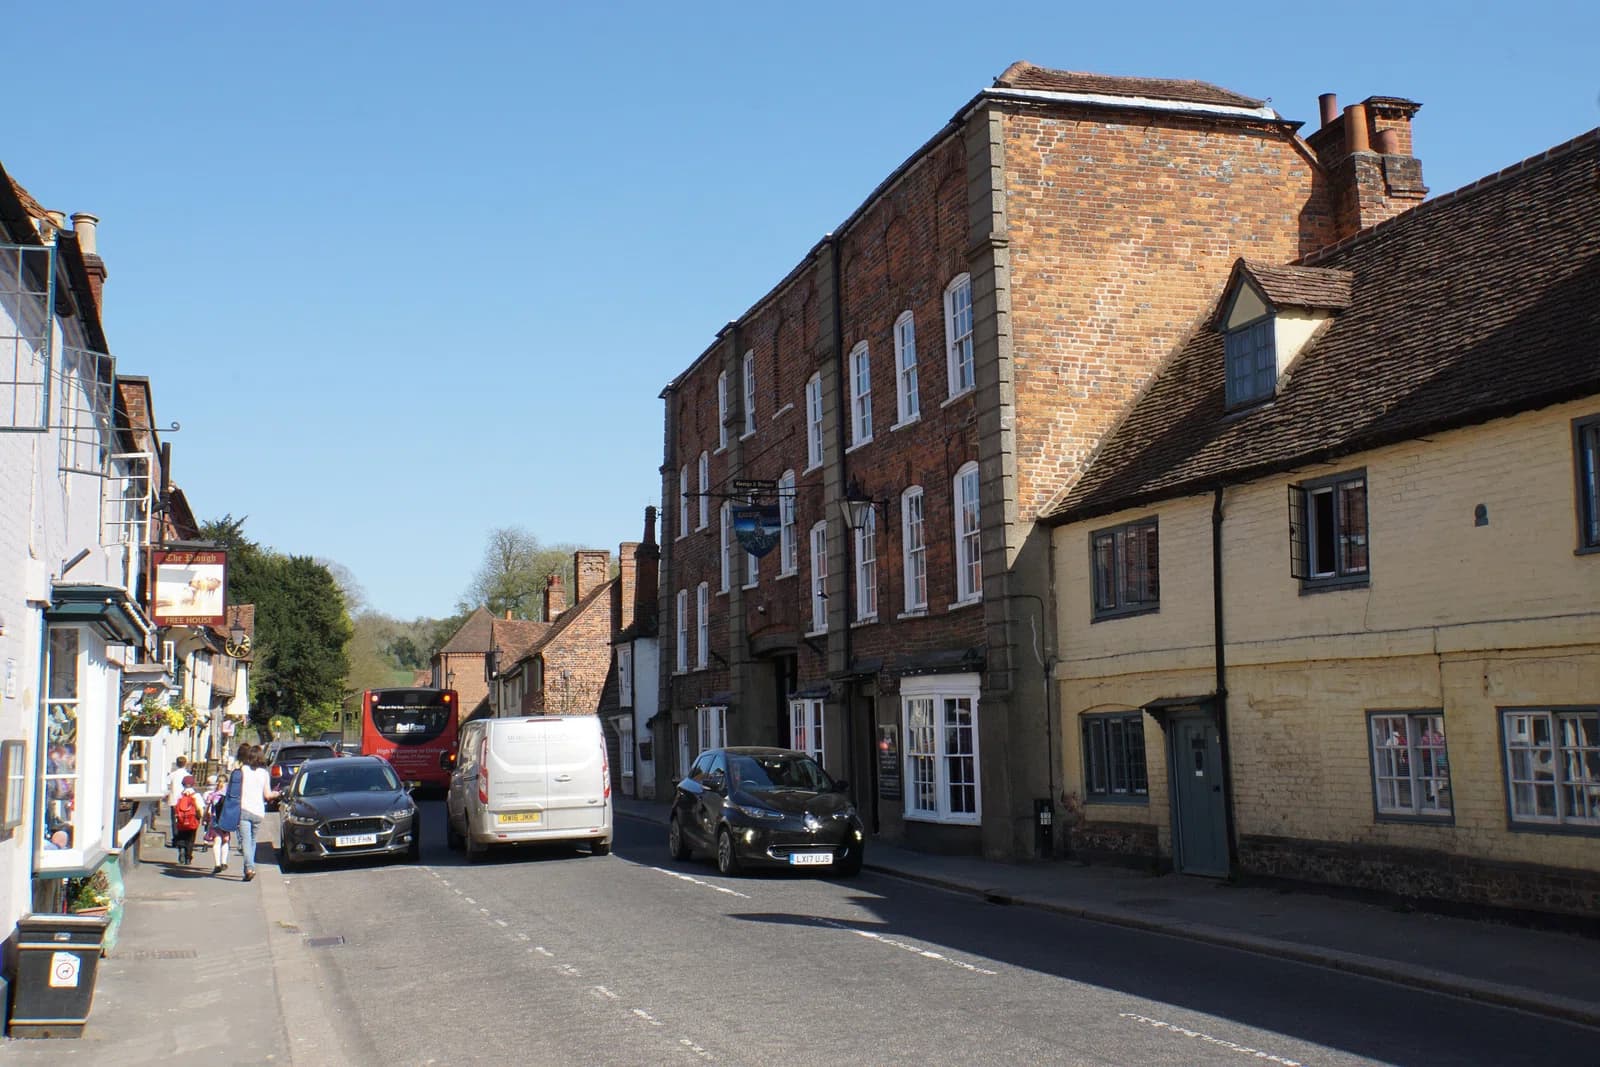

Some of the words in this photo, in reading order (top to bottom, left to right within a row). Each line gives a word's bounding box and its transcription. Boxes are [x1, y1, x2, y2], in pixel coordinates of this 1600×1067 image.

[165, 552, 182, 563] The
[165, 616, 185, 624] FREE
[186, 616, 213, 624] HOUSE
[796, 855, 814, 863] LX17
[815, 854, 830, 863] UJS
